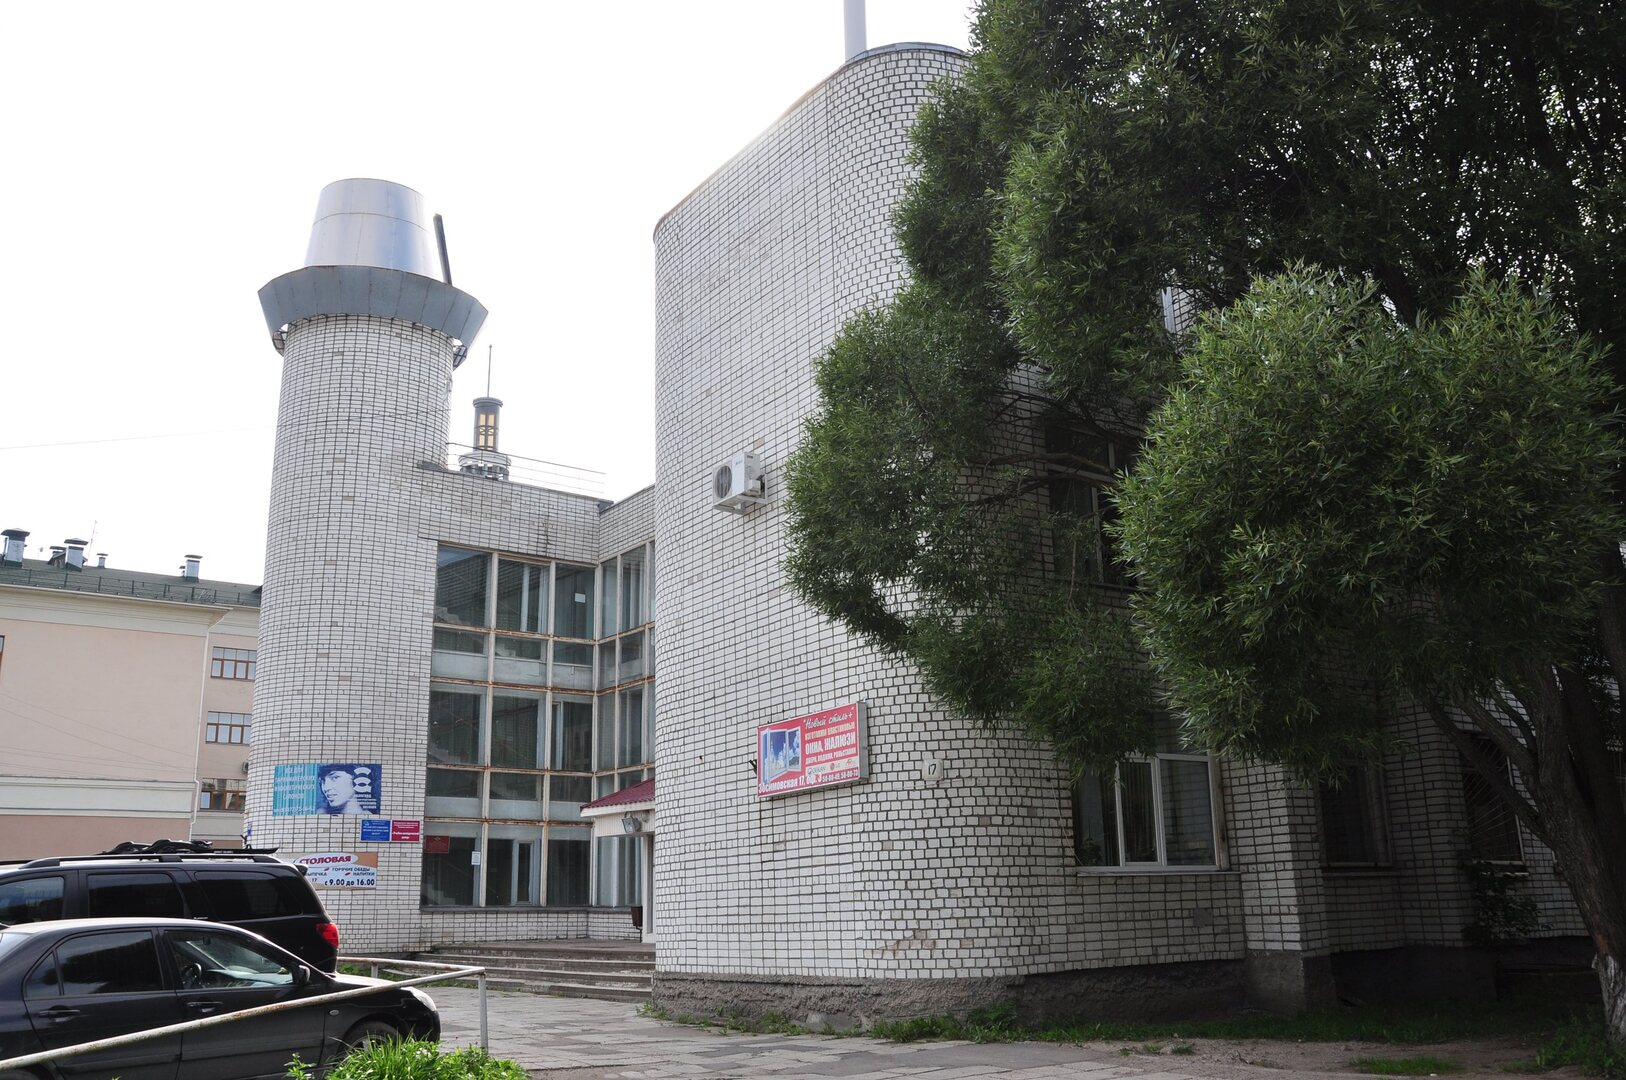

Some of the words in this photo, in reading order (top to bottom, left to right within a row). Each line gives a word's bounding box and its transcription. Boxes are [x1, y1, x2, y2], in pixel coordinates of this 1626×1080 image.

[825, 731, 856, 750] ЖАЛЮЗИ
[928, 763, 937, 776] 17
[299, 855, 352, 865] СТОЛОВАЯ
